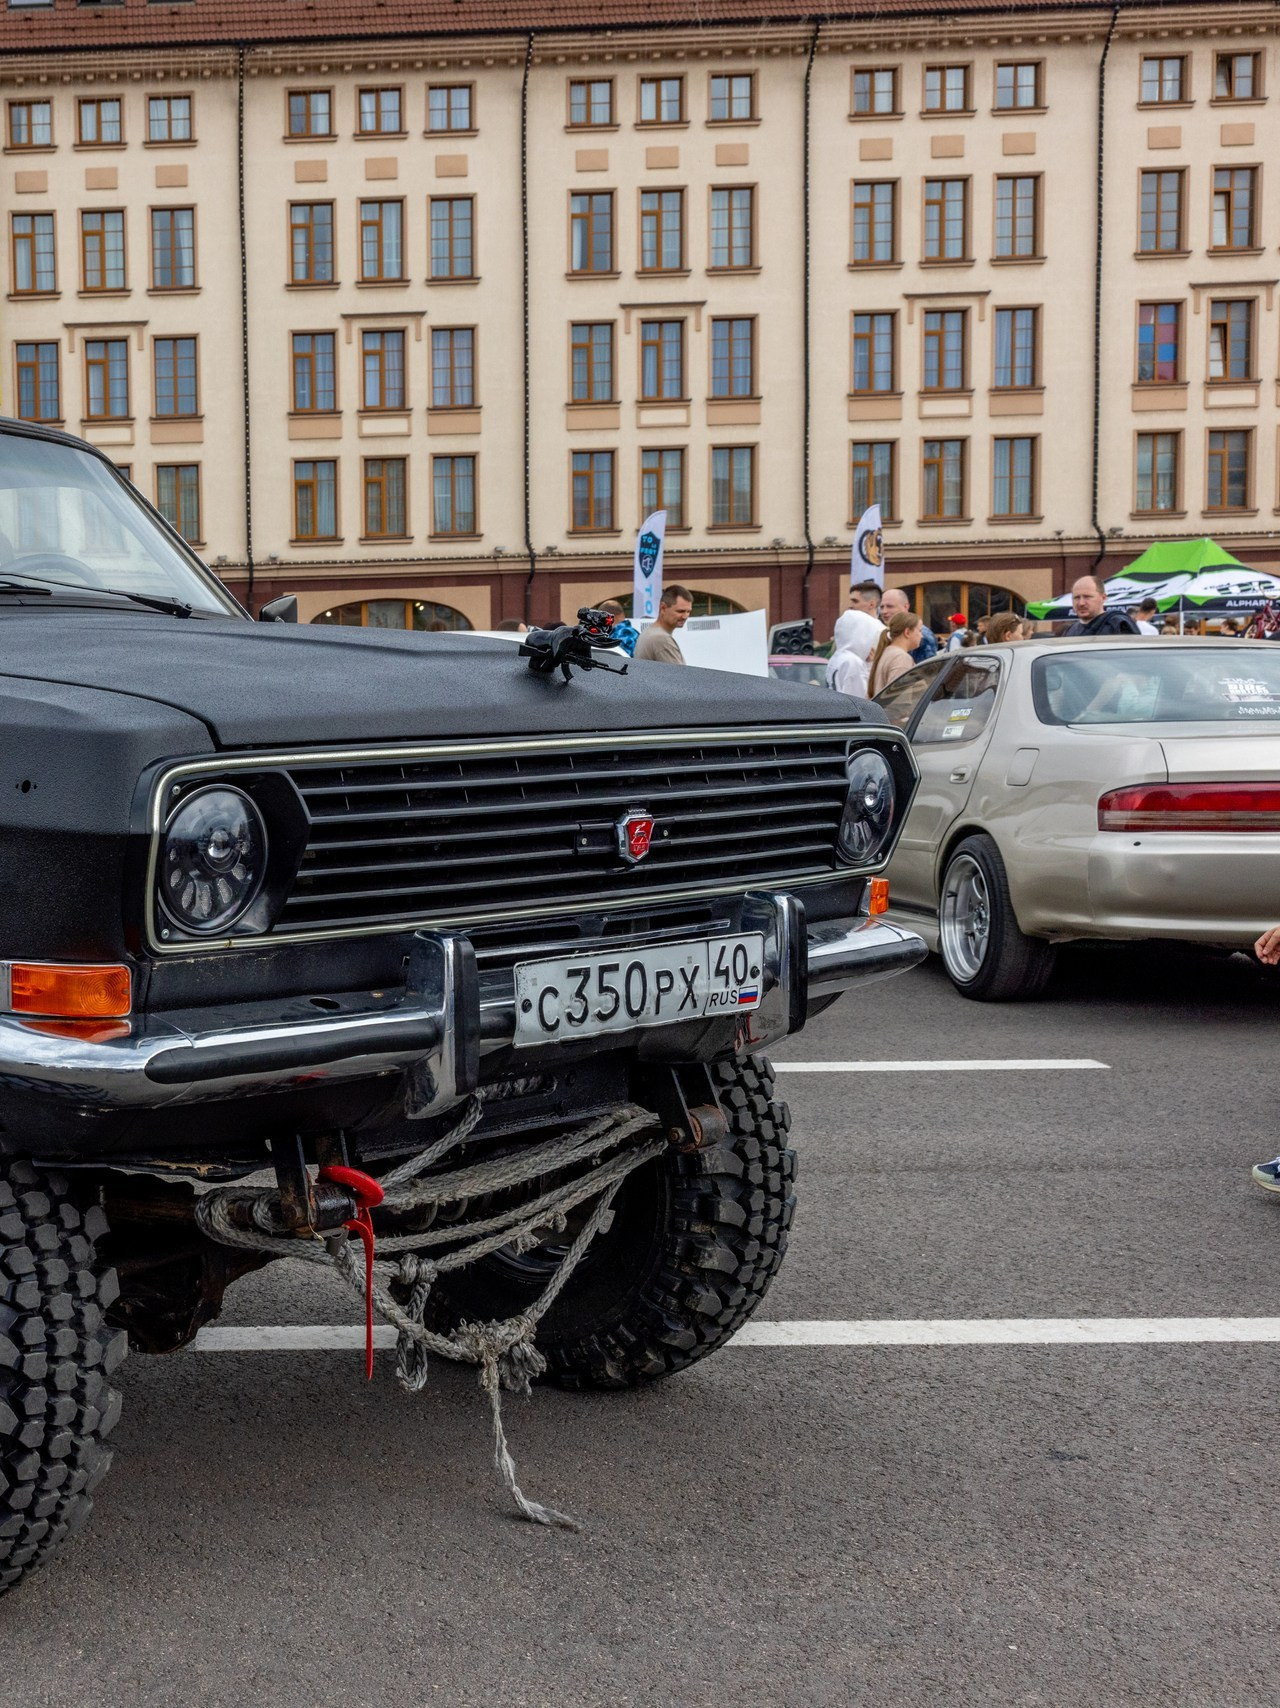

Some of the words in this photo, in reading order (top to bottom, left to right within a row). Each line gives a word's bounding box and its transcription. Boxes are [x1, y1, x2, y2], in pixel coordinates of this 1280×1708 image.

[537, 960, 700, 1033] С350РХ
[713, 944, 749, 988] 40
[708, 989, 738, 1008] RUS
